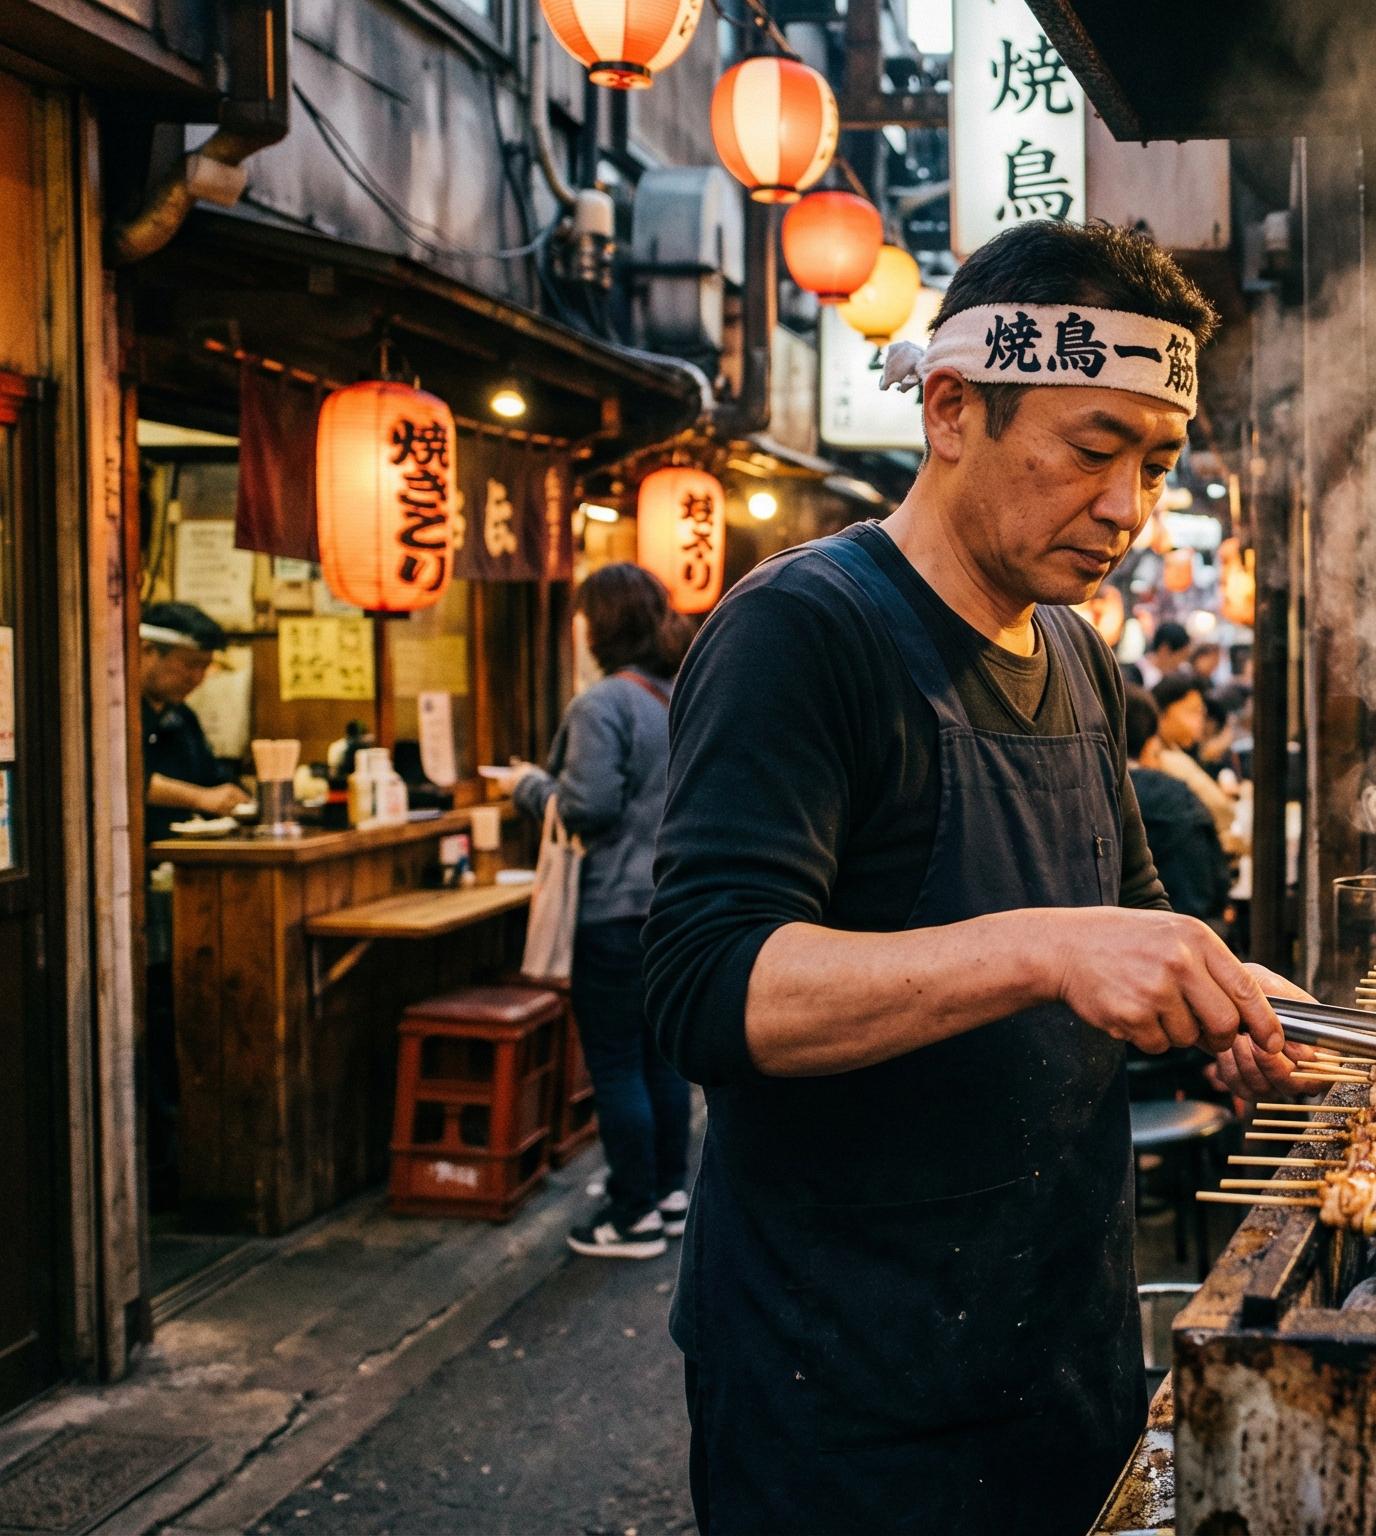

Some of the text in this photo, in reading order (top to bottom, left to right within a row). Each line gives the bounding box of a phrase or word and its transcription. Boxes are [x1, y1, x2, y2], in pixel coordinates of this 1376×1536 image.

[990, 35, 1074, 221] 焼鳥
[984, 311, 1194, 397] 焼鳥一筋
